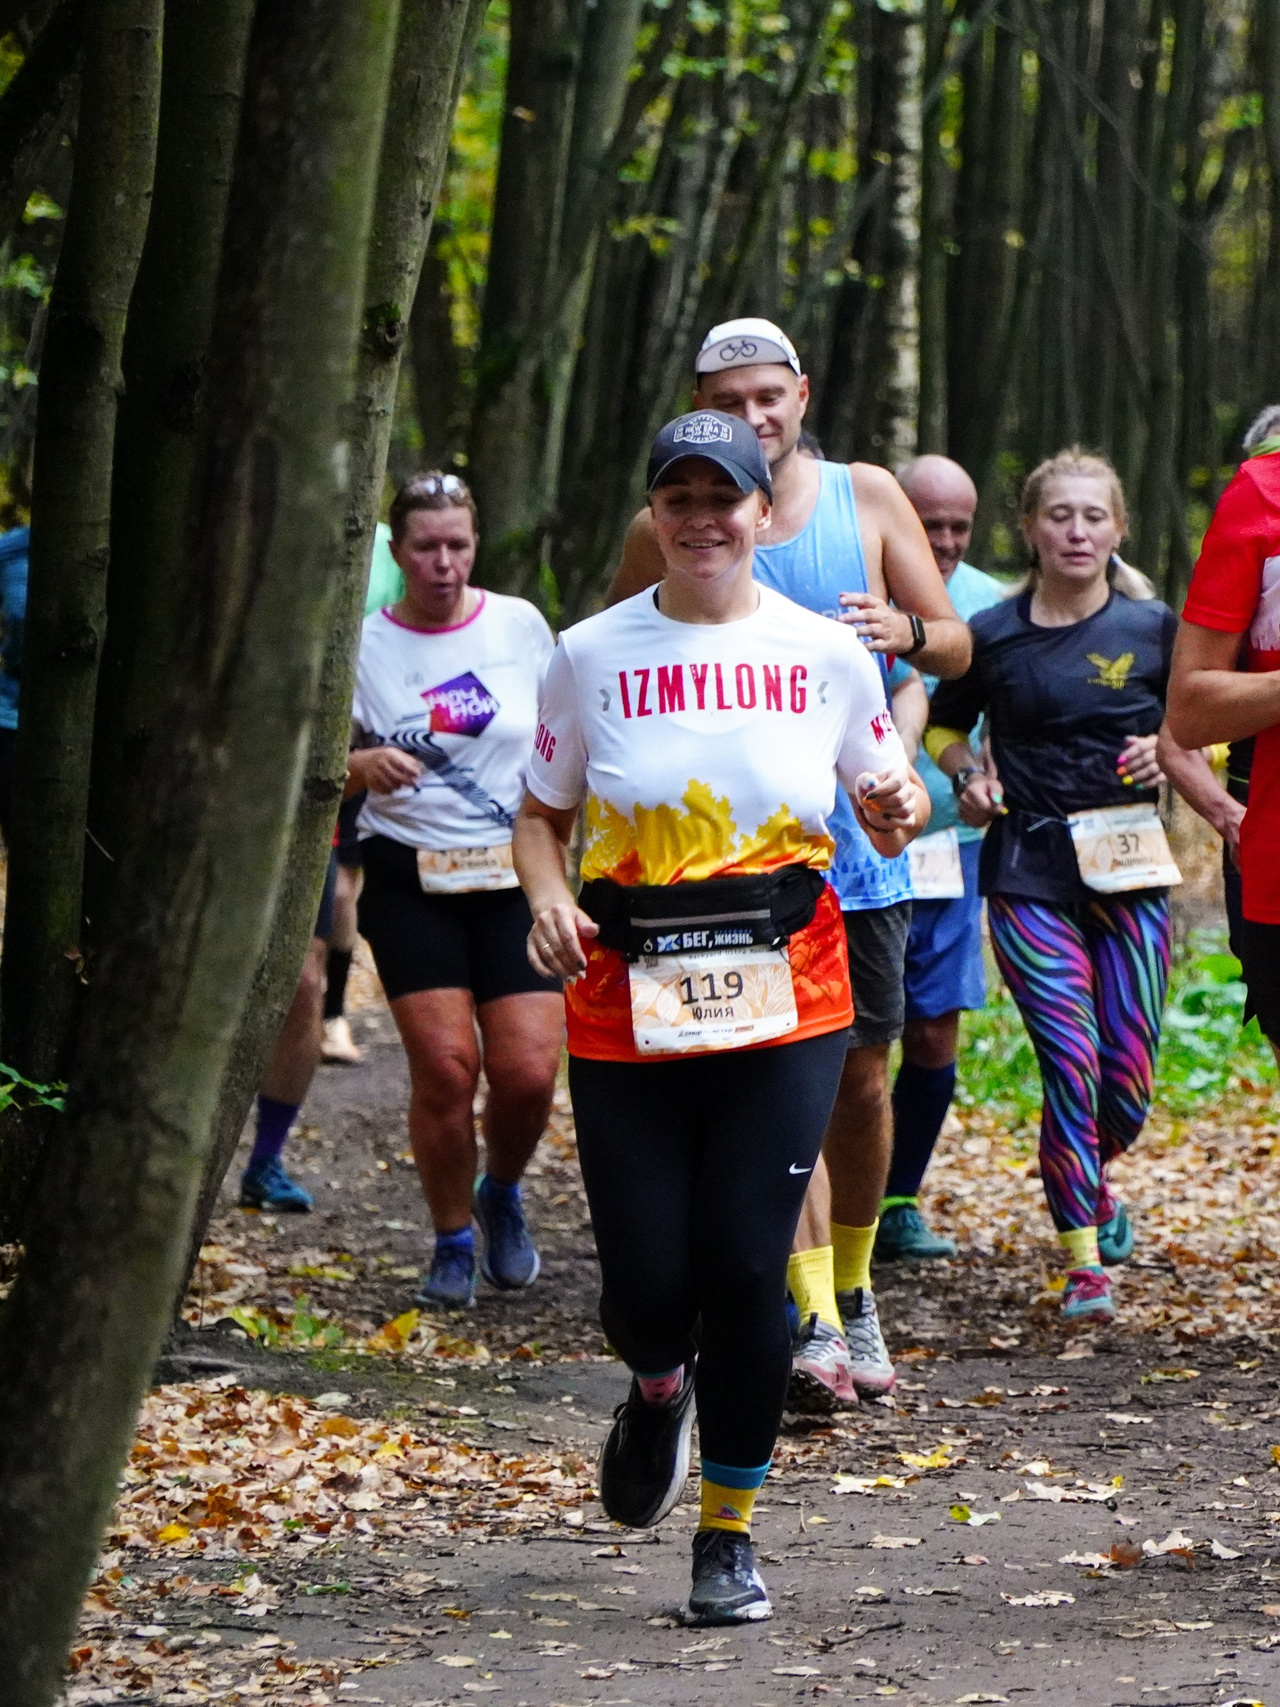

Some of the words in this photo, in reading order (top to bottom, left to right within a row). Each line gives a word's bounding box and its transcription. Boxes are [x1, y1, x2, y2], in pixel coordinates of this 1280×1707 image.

[618, 662, 808, 719] IZMYLONG
[1117, 832, 1140, 855] 37
[682, 930, 714, 949] БЕГ,
[679, 971, 744, 1006] 119
[691, 1006, 735, 1021] Юлия
